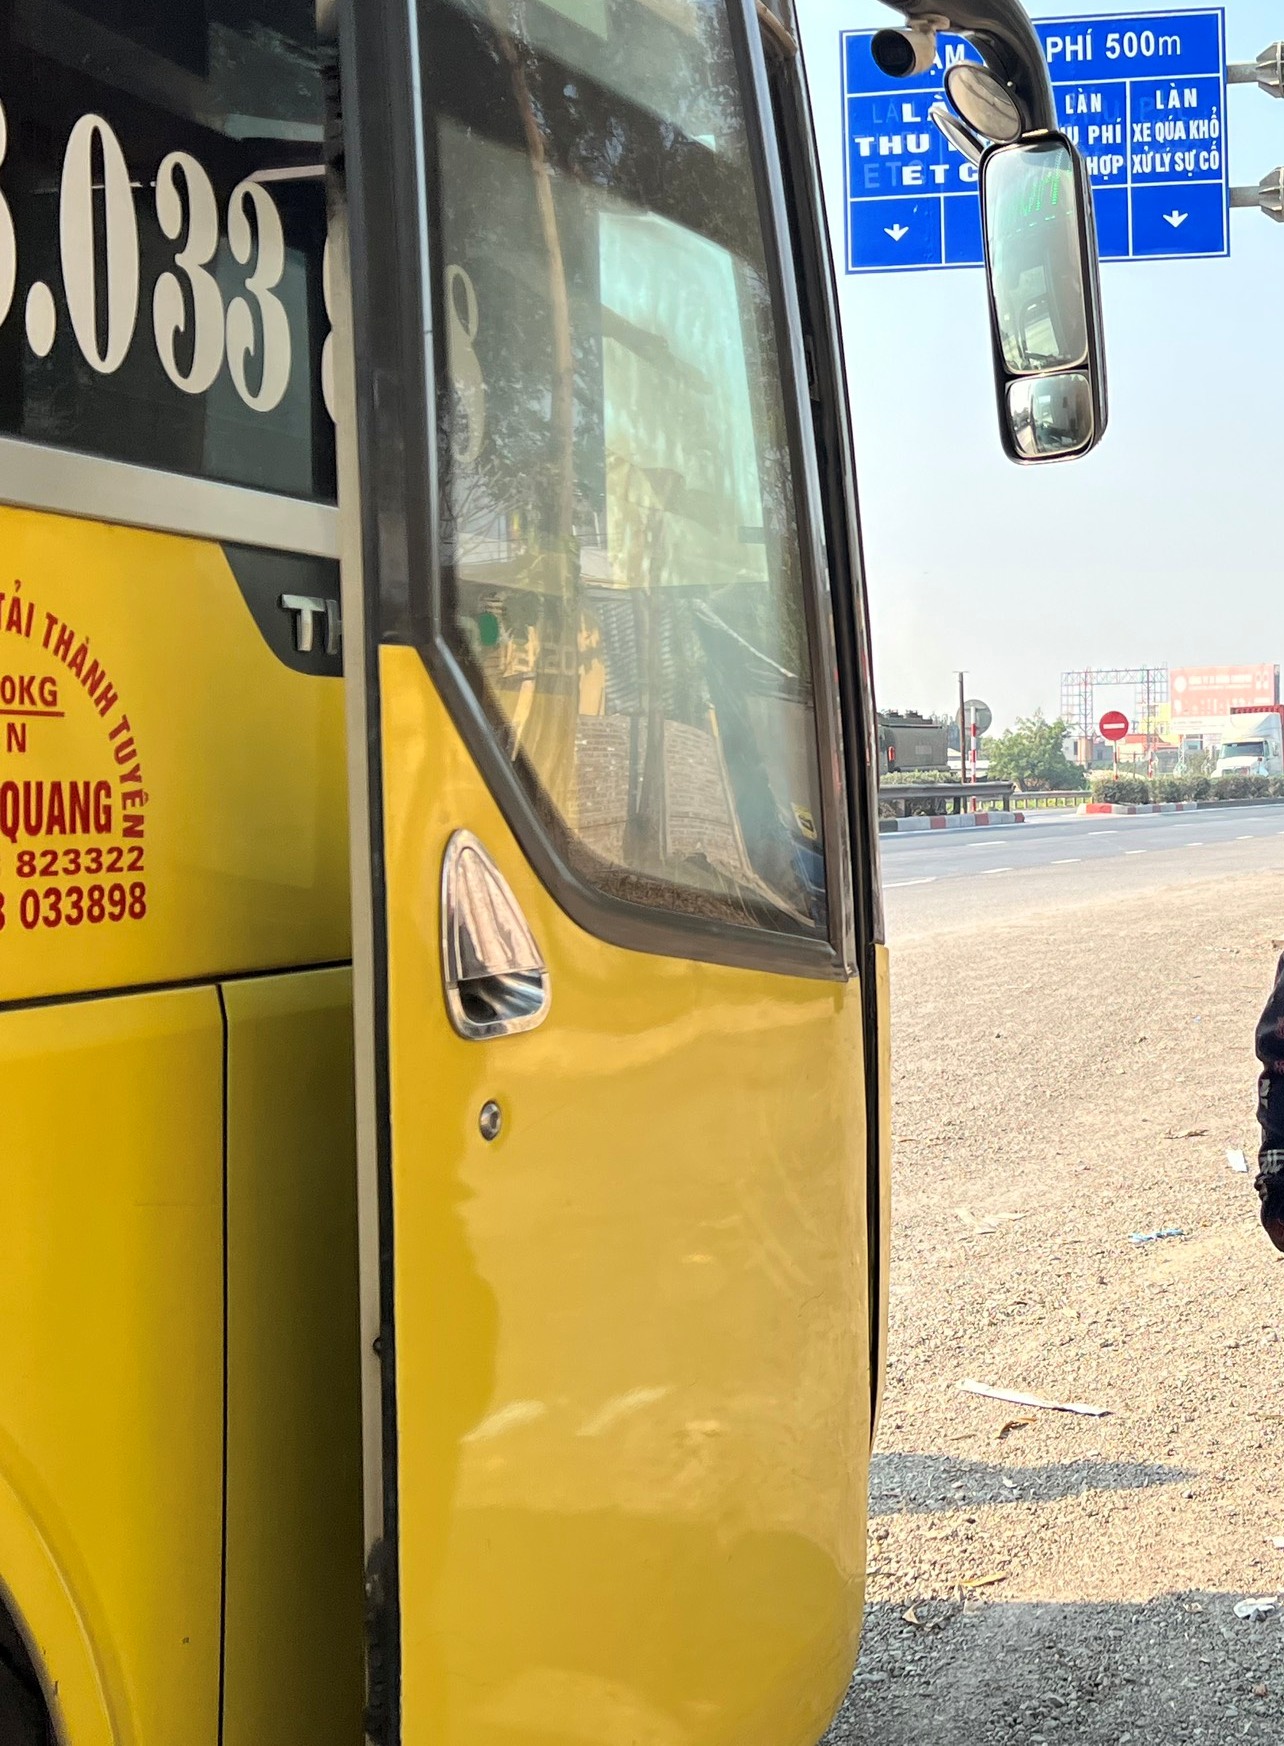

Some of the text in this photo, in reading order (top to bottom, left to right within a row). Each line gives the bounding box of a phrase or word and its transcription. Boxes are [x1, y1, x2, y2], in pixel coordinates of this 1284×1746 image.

[1046, 29, 1093, 62] PHÍ
[1106, 31, 1181, 59] 500m
[1065, 88, 1102, 114] LÀN
[1156, 83, 1198, 110] LÀN
[1088, 118, 1122, 144] PHÍ
[1133, 123, 1152, 142] XE
[1189, 106, 1219, 139] KHỔ
[854, 133, 930, 156] THU
[1132, 141, 1219, 176] XỬ LÝ SỰ CỐ
[902, 163, 978, 185] ETC
[42, 611, 119, 718] THÀNH
[108, 714, 149, 839] TUYÊN
[0, 780, 112, 843] QUANG
[16, 845, 145, 878] 823322
[20, 881, 147, 929] 033898
